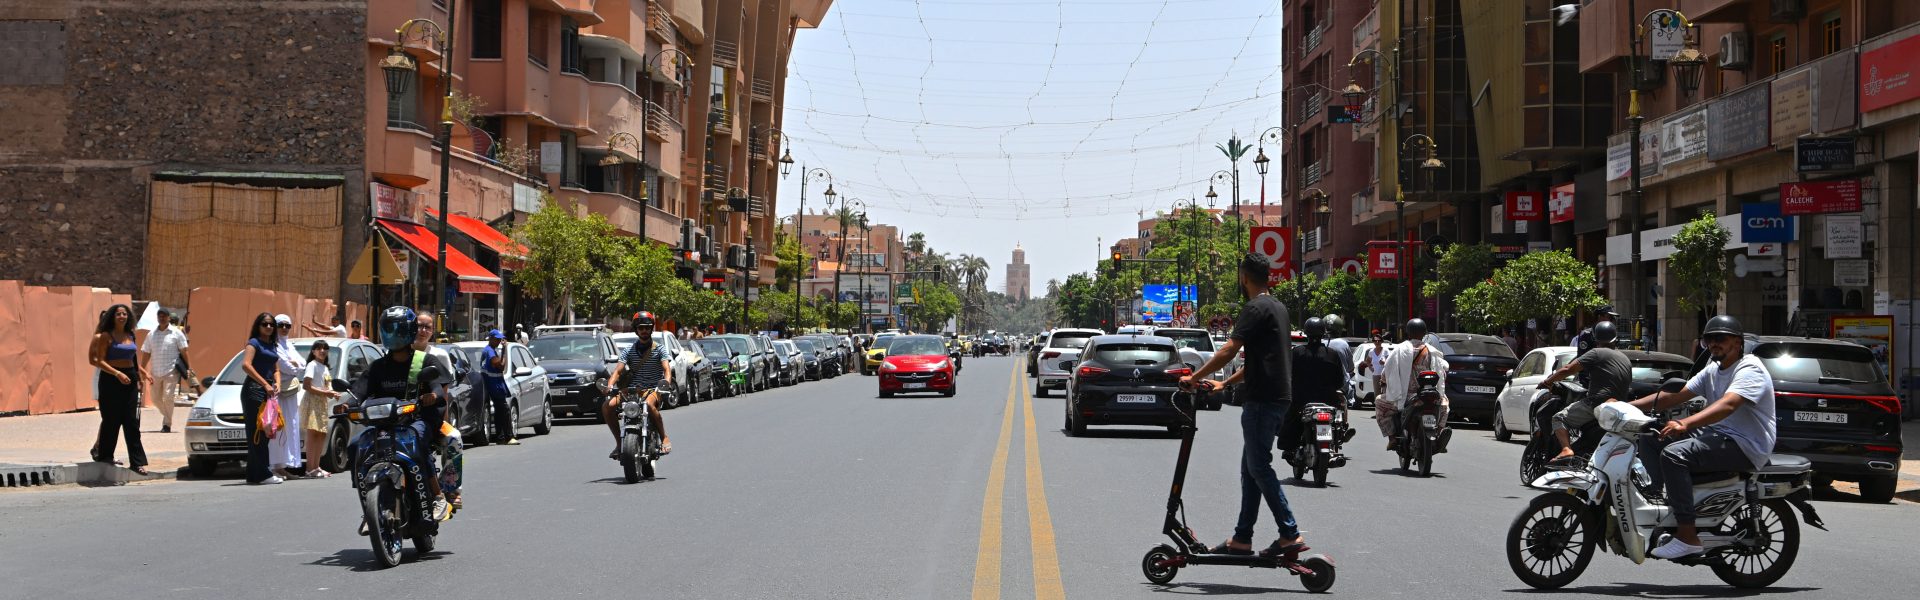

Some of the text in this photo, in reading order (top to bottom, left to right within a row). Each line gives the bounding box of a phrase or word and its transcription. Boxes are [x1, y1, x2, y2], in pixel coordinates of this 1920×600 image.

[1748, 89, 1767, 107] CAR
[1785, 196, 1814, 205] CALECHE
[1797, 412, 1819, 422] 52729
[1836, 414, 1845, 423] 26
[1614, 483, 1630, 533] SWING
